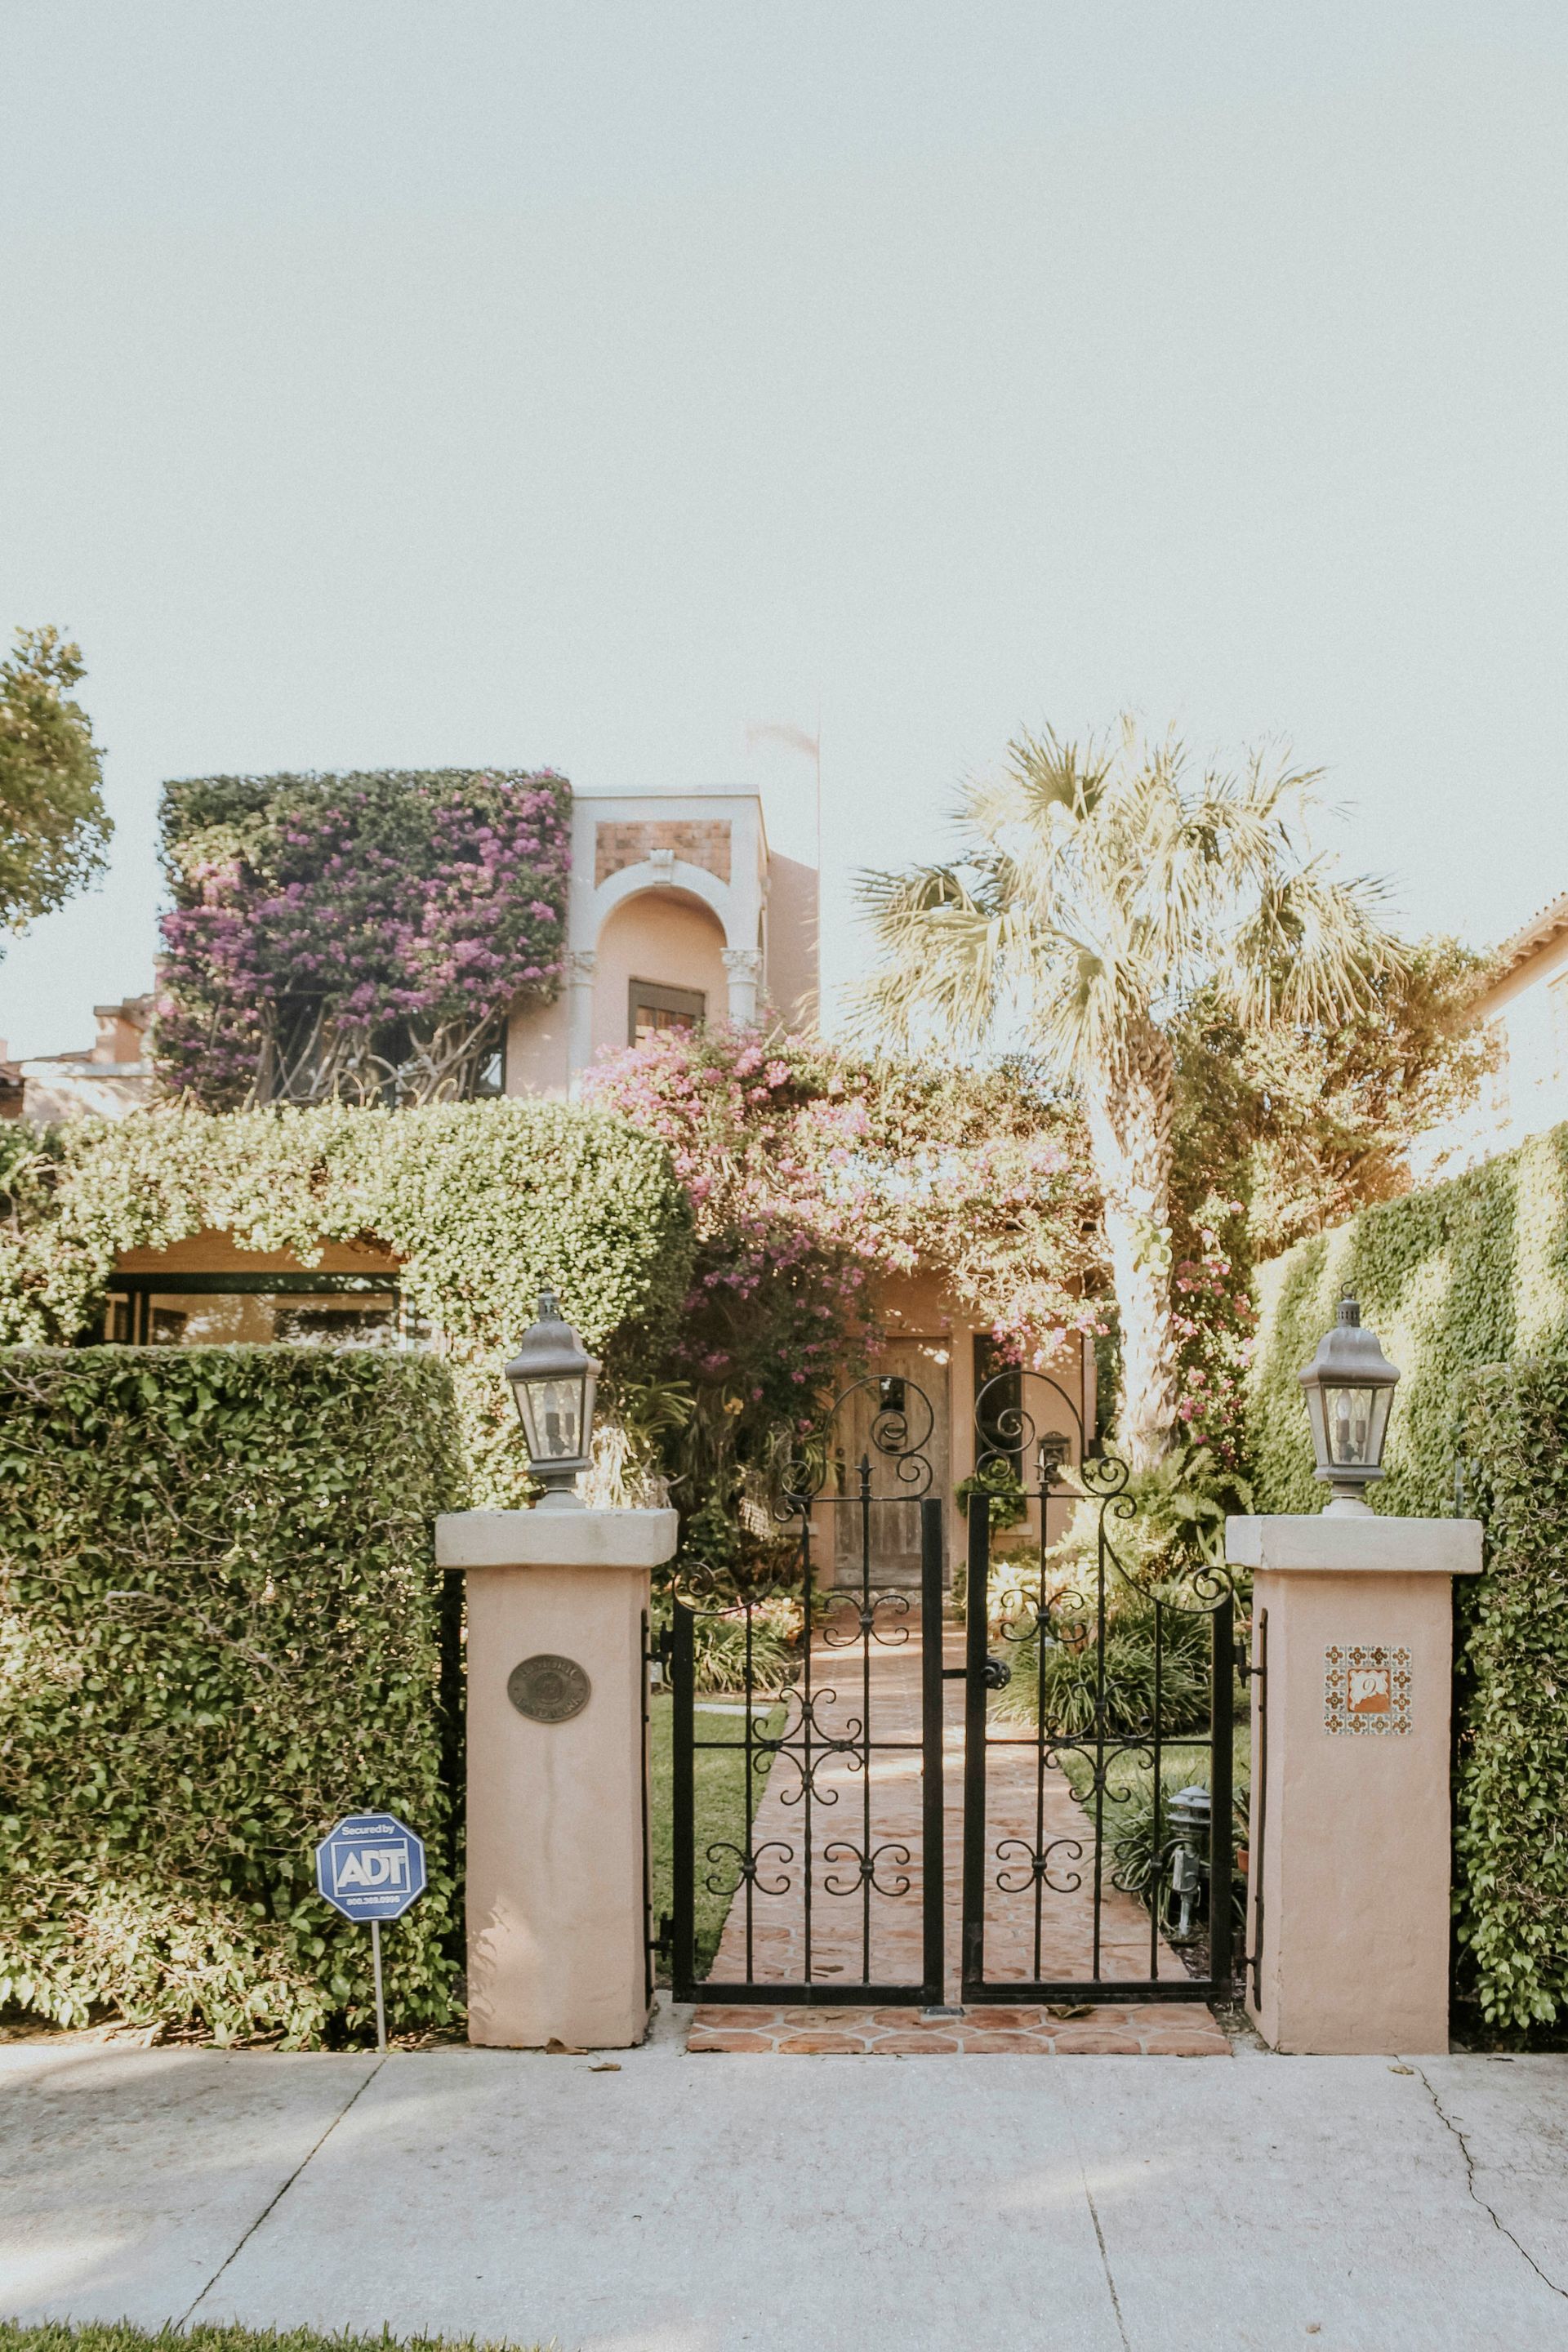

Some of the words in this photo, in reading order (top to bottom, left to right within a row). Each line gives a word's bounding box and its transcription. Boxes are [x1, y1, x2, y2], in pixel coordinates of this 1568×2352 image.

[342, 1825, 382, 1835] Secured
[382, 1824, 394, 1834] by
[337, 1848, 406, 1887] ADT
